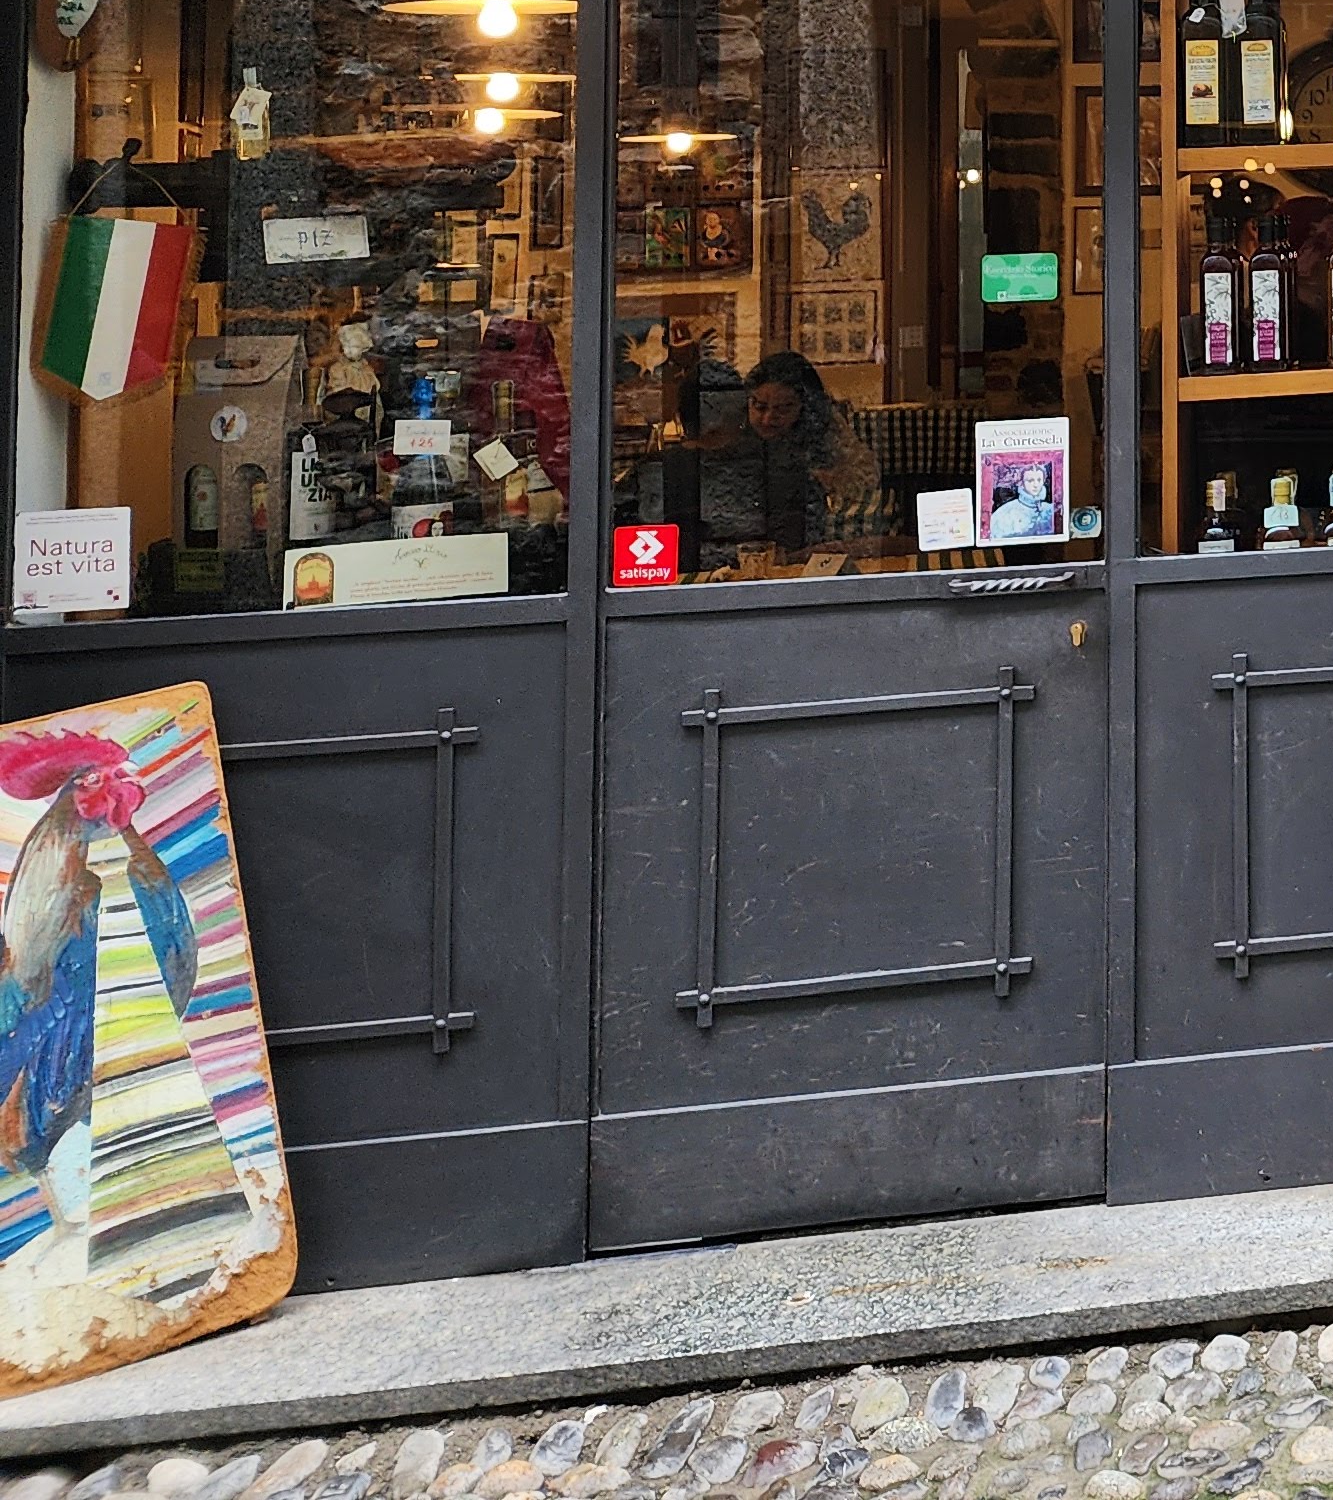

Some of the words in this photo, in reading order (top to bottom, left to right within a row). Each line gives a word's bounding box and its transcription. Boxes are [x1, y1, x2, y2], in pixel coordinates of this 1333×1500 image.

[981, 439, 996, 448] La
[30, 538, 114, 558] Natura
[26, 559, 63, 577] est
[71, 555, 116, 574] vita
[619, 566, 671, 581] satispay
